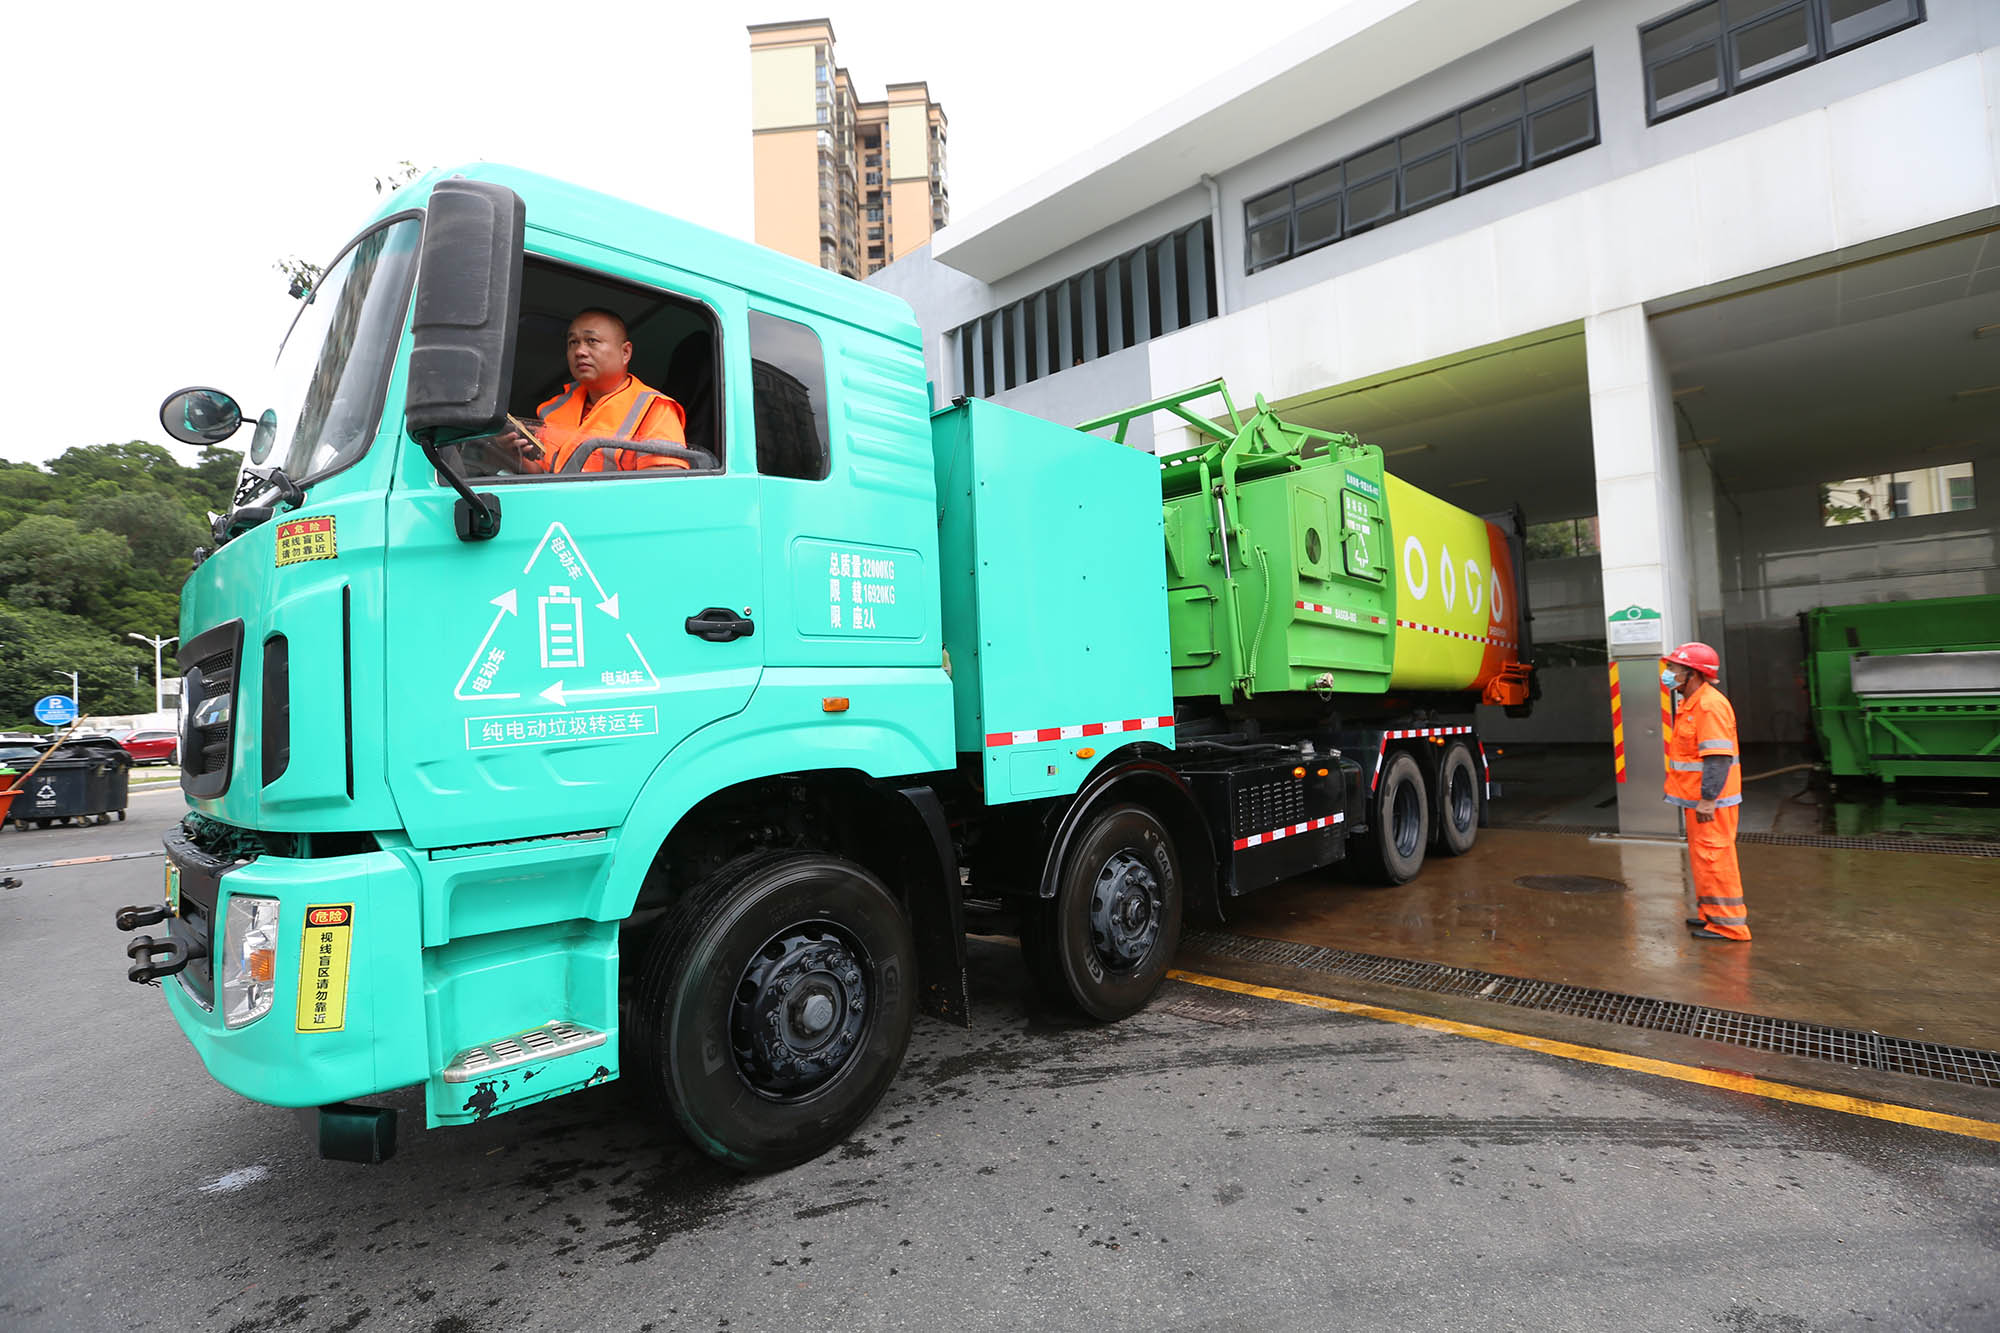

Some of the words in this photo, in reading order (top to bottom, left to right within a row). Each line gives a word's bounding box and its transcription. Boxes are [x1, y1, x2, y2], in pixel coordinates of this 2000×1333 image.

[294, 522, 320, 534] 危险
[282, 534, 325, 549] 视线盲区
[282, 544, 326, 559] 请勿靠近
[551, 537, 583, 580] 电动车
[472, 647, 506, 693] 电动车
[601, 670, 644, 685] 电动车
[482, 712, 645, 742] 纯电动垃圾转运车
[315, 911, 343, 923] 危险
[313, 932, 333, 1024] 视线盲区请勿靠近
